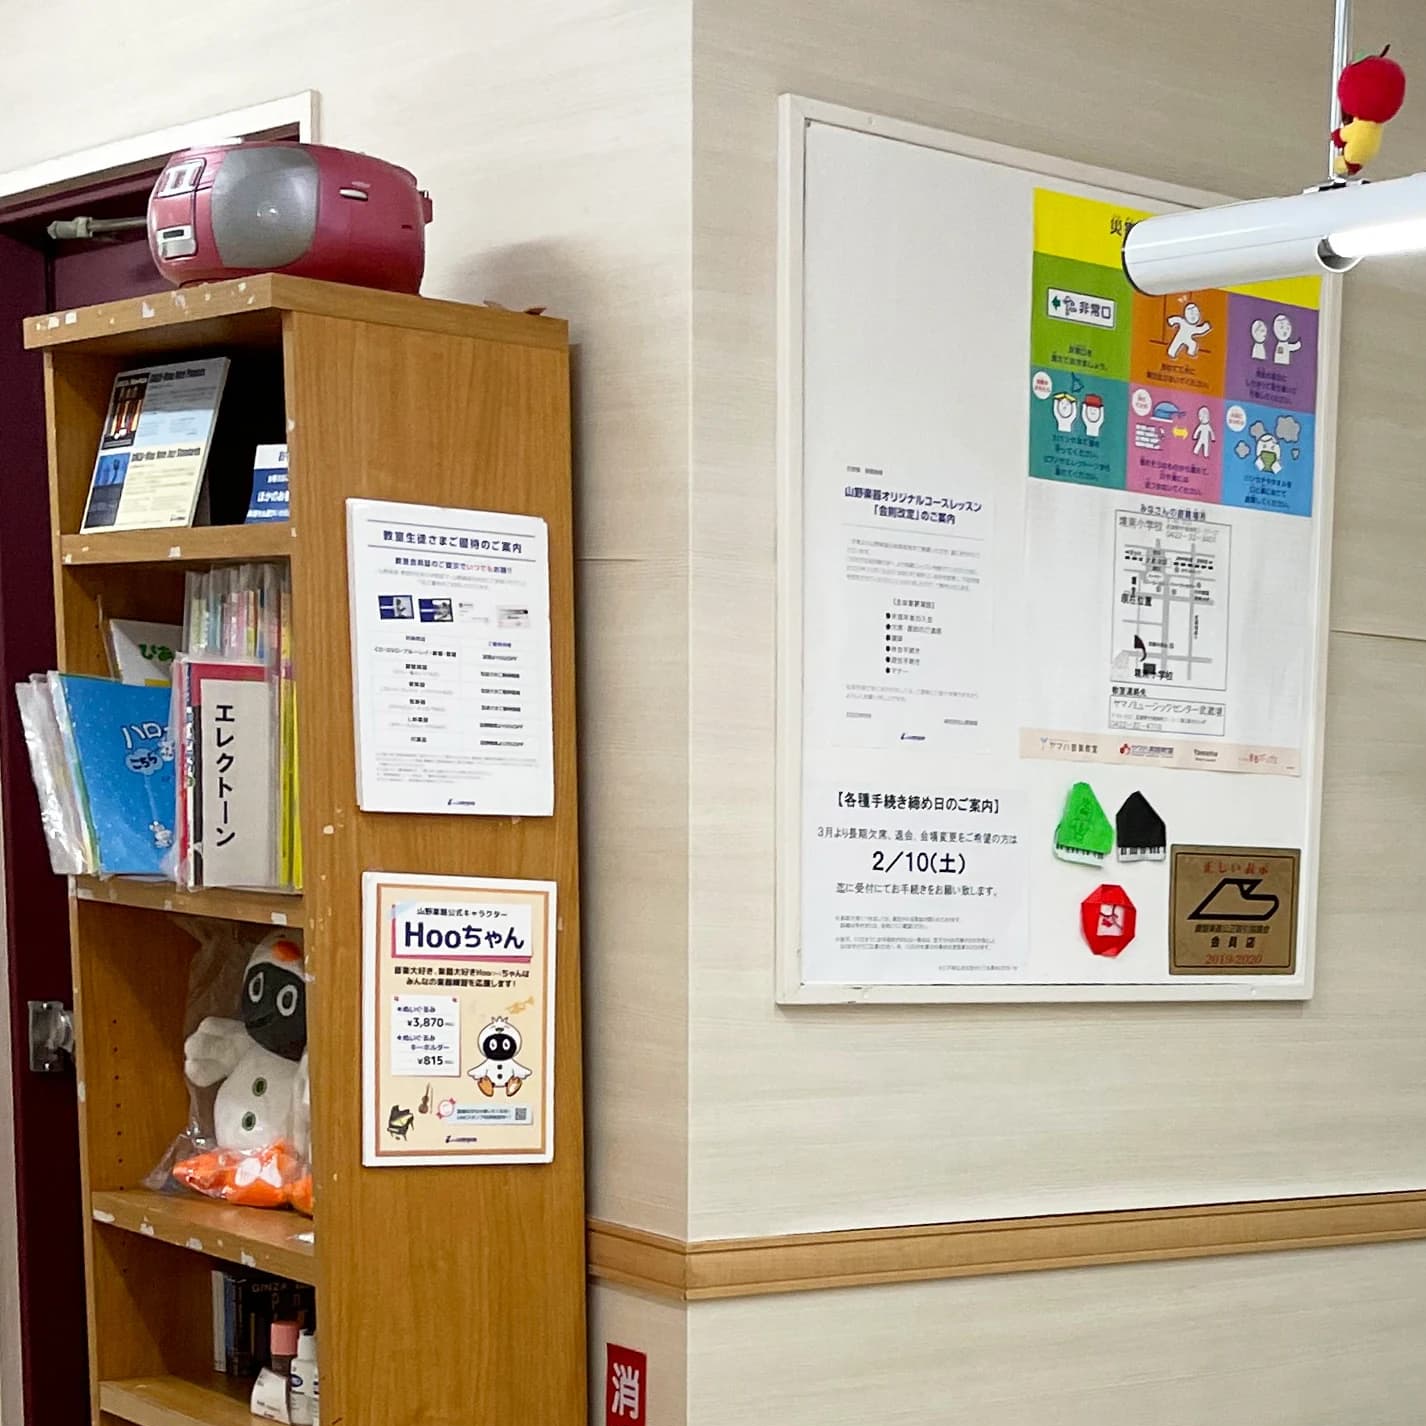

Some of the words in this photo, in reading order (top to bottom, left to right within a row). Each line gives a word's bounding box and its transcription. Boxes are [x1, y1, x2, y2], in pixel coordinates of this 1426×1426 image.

[1078, 301, 1112, 320] 非常口
[845, 486, 982, 513] 山野楽器オリジナルコースレッスン
[214, 704, 236, 847] エレクトーン
[836, 791, 1000, 815] 【各種手続き締め日のご案内】
[404, 921, 525, 950] Hooちゃん
[407, 1017, 444, 1028] ¥3,870
[417, 1055, 444, 1066] ¥815
